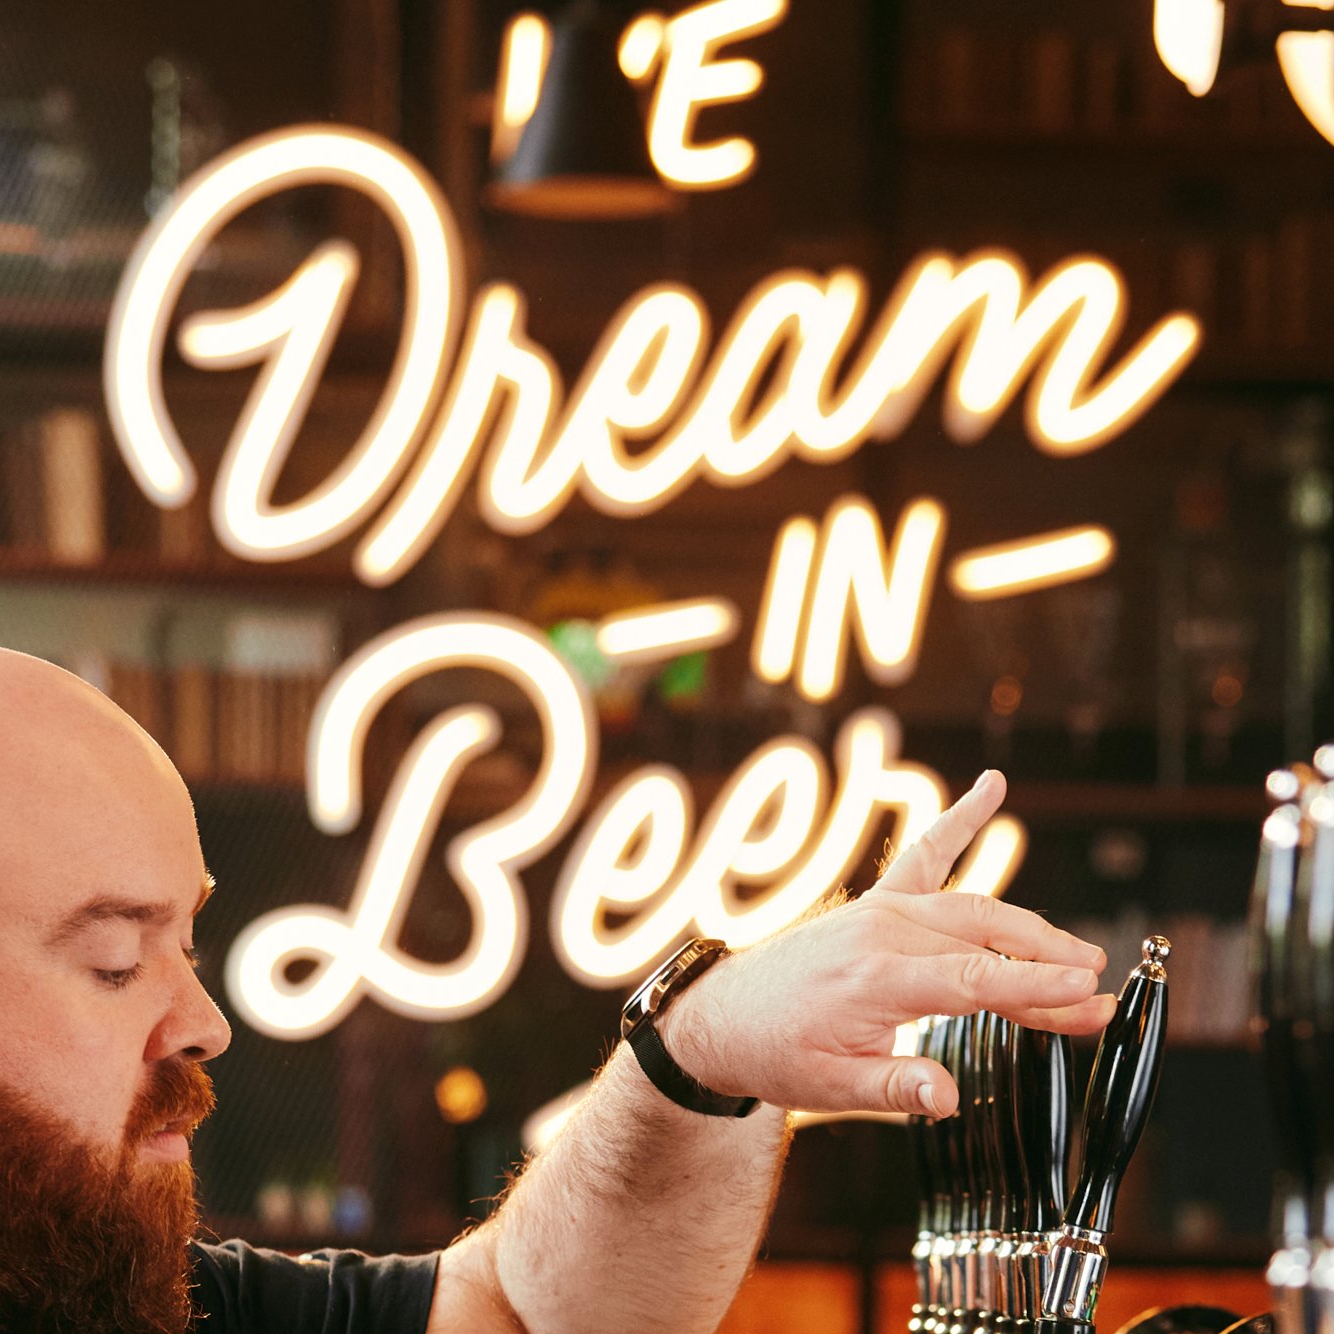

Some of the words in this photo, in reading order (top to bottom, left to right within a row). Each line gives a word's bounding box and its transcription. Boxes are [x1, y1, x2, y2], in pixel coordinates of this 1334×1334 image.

[106, 124, 1198, 582] Dream
[755, 499, 944, 700] IN
[228, 613, 1026, 1037] Beer
